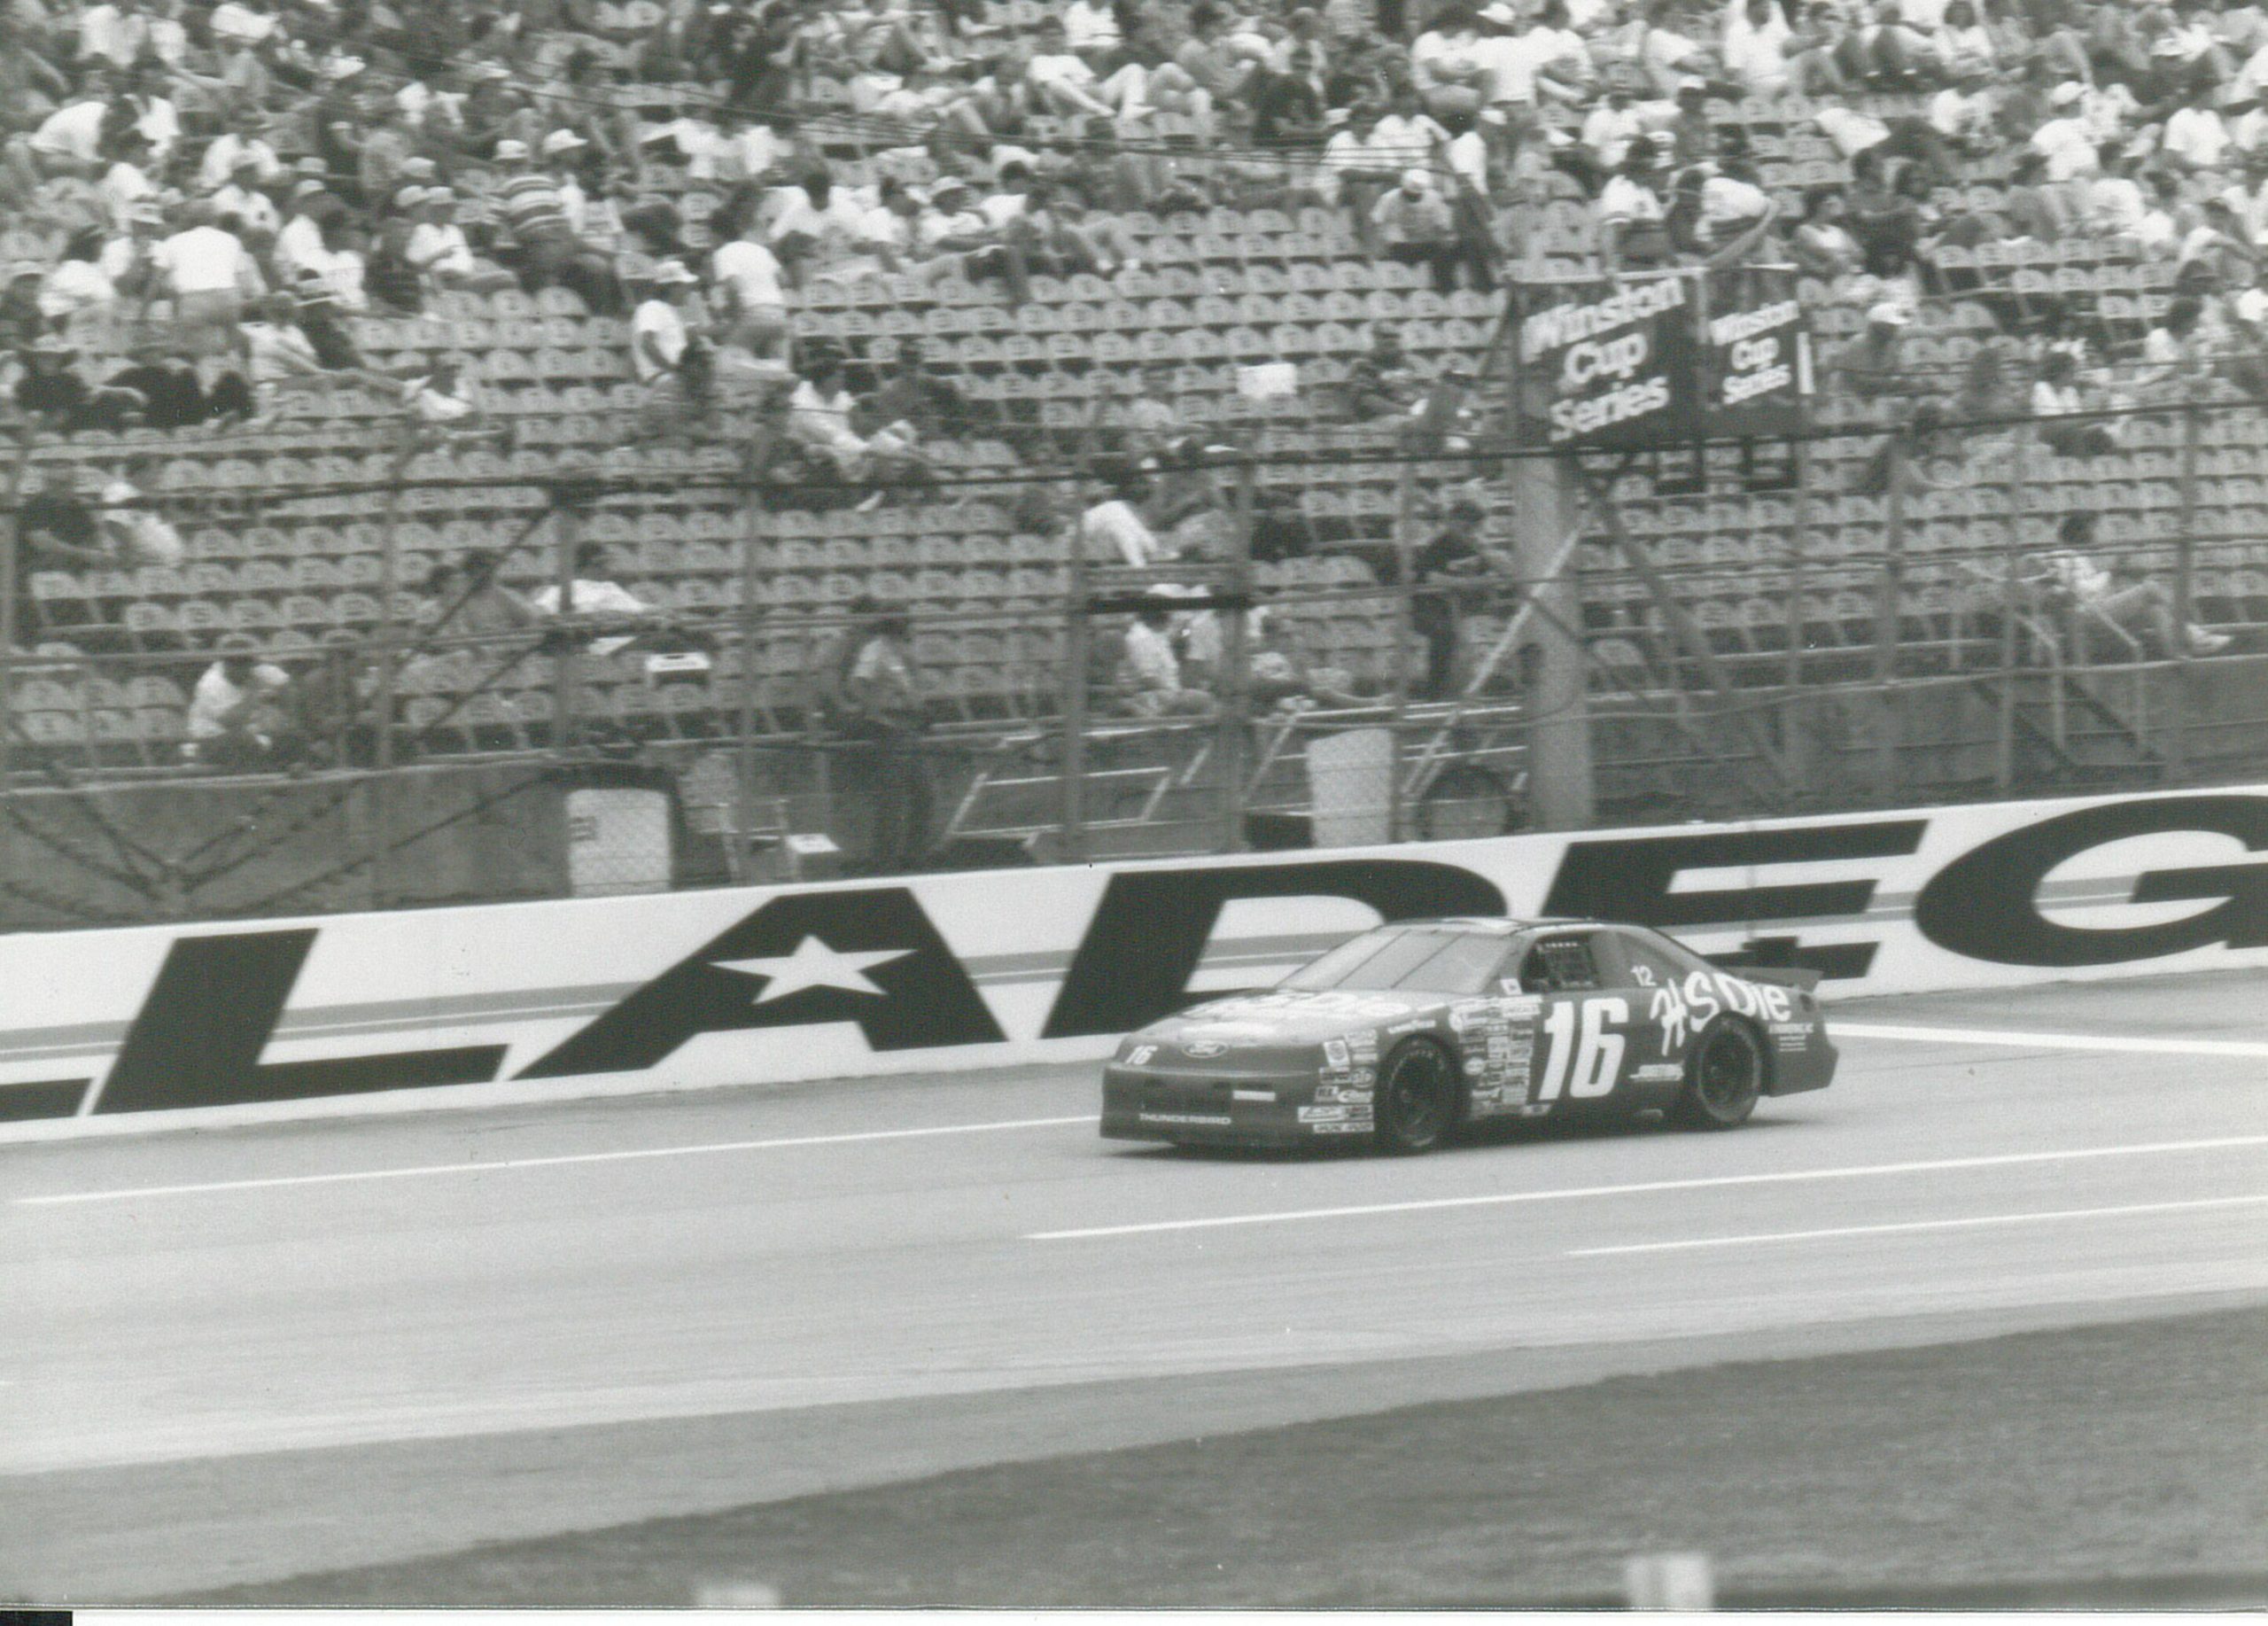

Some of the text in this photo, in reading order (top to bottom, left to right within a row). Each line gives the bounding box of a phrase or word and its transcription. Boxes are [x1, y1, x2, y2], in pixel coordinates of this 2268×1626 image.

[1519, 277, 1685, 364] Winston
[1563, 332, 1648, 385] Cup
[1549, 377, 1671, 441] Series
[0, 792, 2268, 1122] LADEG
[1630, 965, 1657, 986] 12
[1125, 1045, 1158, 1065] 16
[1538, 997, 1629, 1101] 16
[1138, 1112, 1232, 1125] THUNDERBIRD
